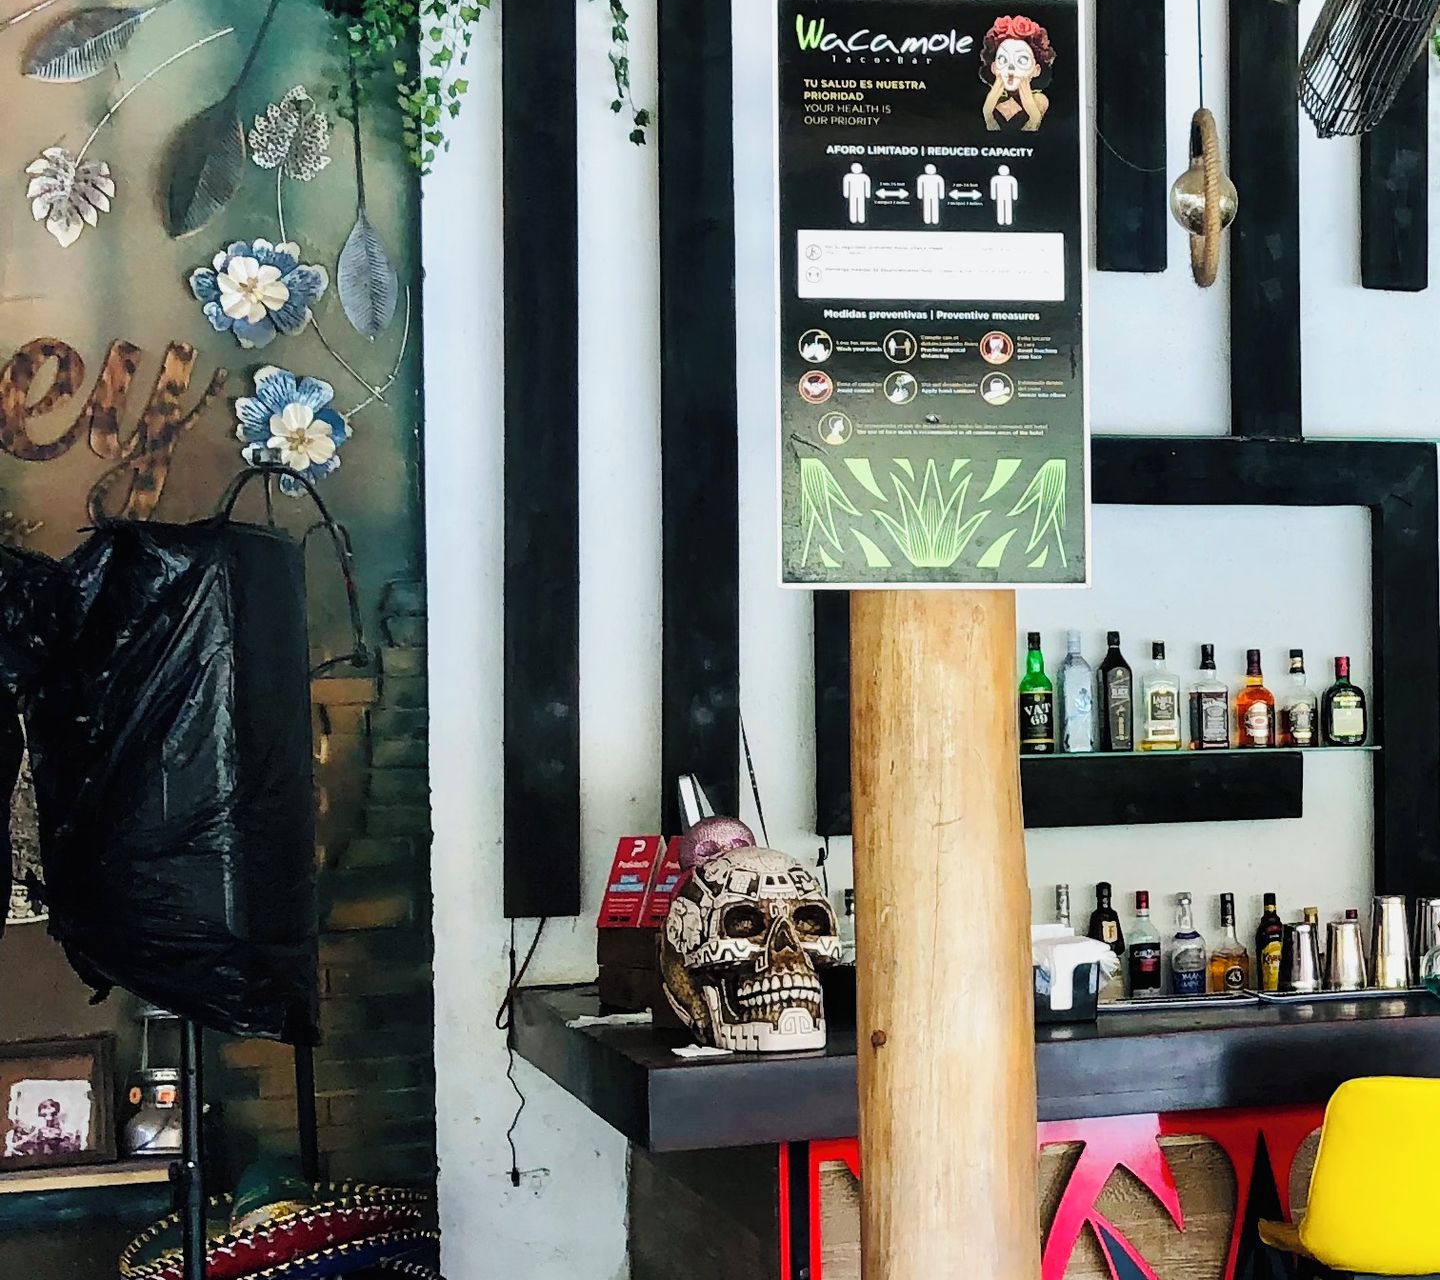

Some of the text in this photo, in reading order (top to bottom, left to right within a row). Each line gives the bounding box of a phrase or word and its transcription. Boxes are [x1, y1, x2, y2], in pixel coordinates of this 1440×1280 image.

[795, 14, 974, 56] Wacamole
[803, 78, 927, 91] TU SALUD ES NUESTRA
[803, 91, 865, 102] PRIORIDAD
[804, 103, 892, 115] YOUR HEALTH IS
[804, 115, 881, 127] OUR PRIORITY
[826, 145, 1034, 158] AFORO LIMITADO REDUCED CAPACITY
[823, 309, 1041, 321] Medidas preventivas Preventive measures
[1023, 702, 1052, 717] VAT
[1228, 970, 1242, 982] 43
